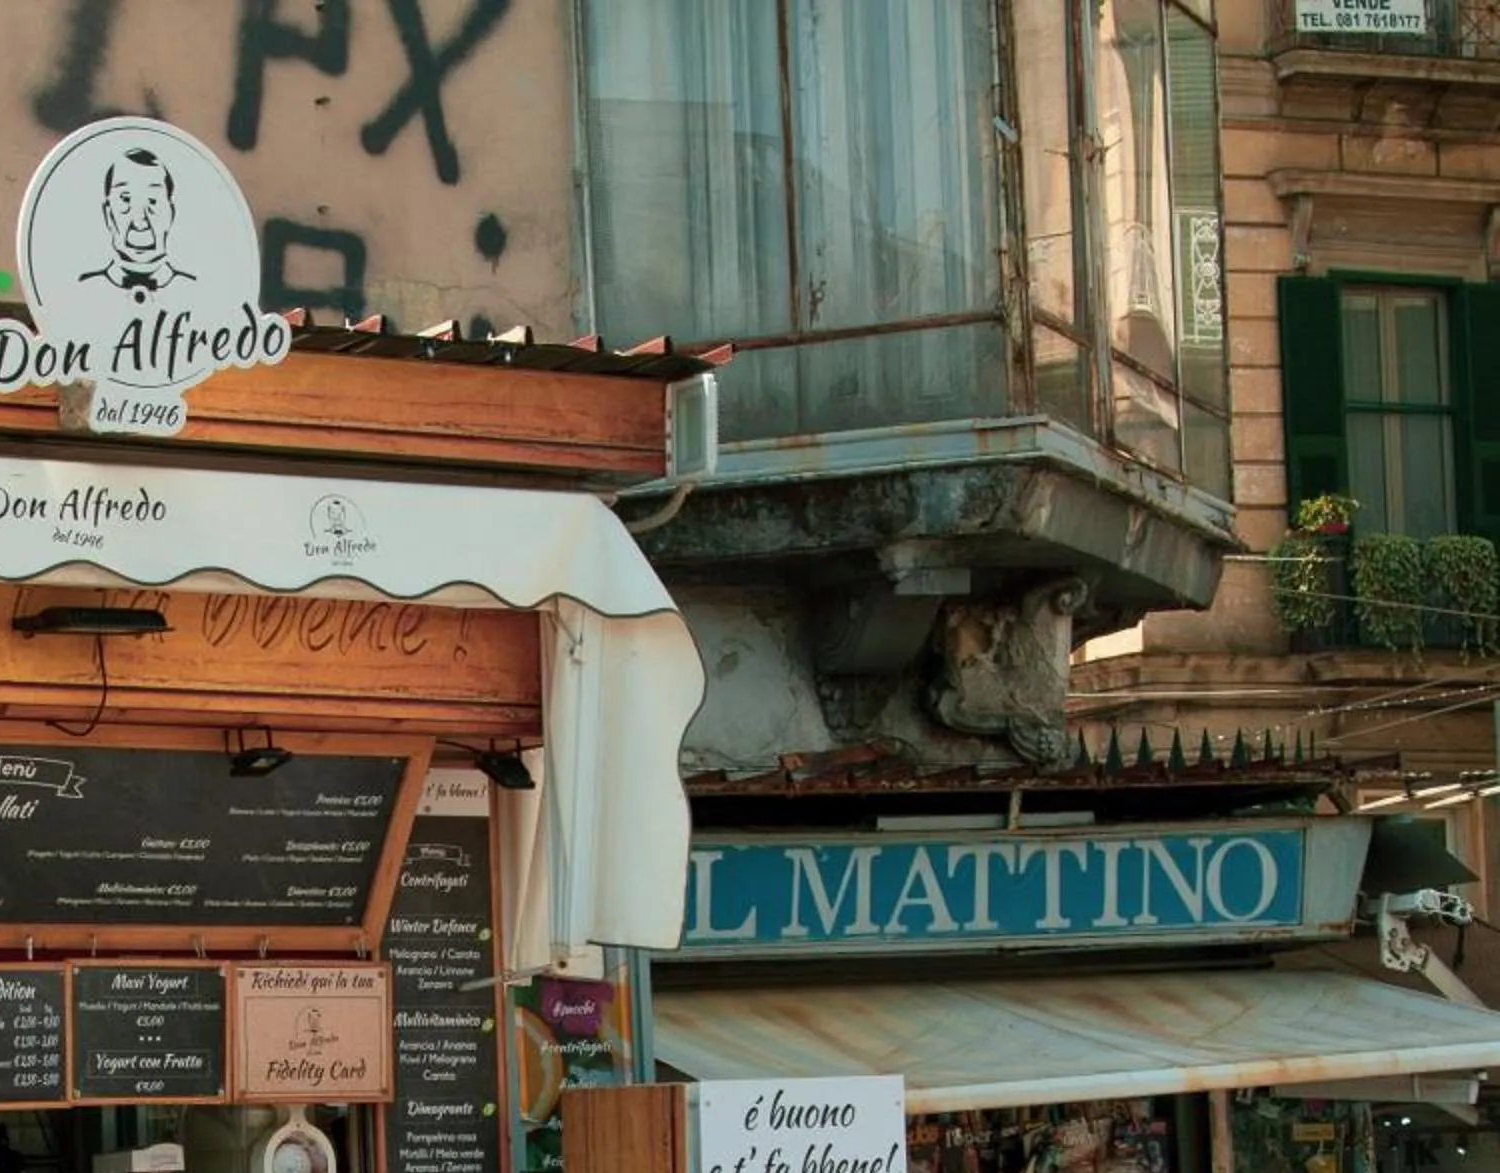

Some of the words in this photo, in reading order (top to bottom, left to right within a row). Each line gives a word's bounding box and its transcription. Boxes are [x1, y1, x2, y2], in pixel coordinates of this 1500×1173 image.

[1302, 13, 1332, 27] TEL.
[1336, 13, 1359, 27] 081
[112, 301, 285, 380] Alfredo
[96, 398, 127, 423] dal
[131, 402, 181, 426] 1946
[60, 485, 167, 528] Alfredo
[52, 527, 73, 545] dal
[73, 530, 105, 549] 1946
[304, 542, 329, 557] Don
[333, 537, 377, 558] Alfredo
[687, 850, 758, 940] L
[780, 836, 1279, 938] MATTINO
[390, 918, 431, 934] Winter
[111, 973, 145, 991] Maxi
[149, 973, 189, 994] Yogurt
[251, 970, 307, 990] Richiedi
[310, 974, 332, 994] qui
[335, 971, 348, 989] la
[351, 975, 375, 989] tua
[96, 1053, 138, 1075] Yogurt
[139, 1056, 162, 1070] con
[265, 1058, 326, 1087] Fidelity
[329, 1058, 368, 1081] Card
[769, 1089, 856, 1131] buono
